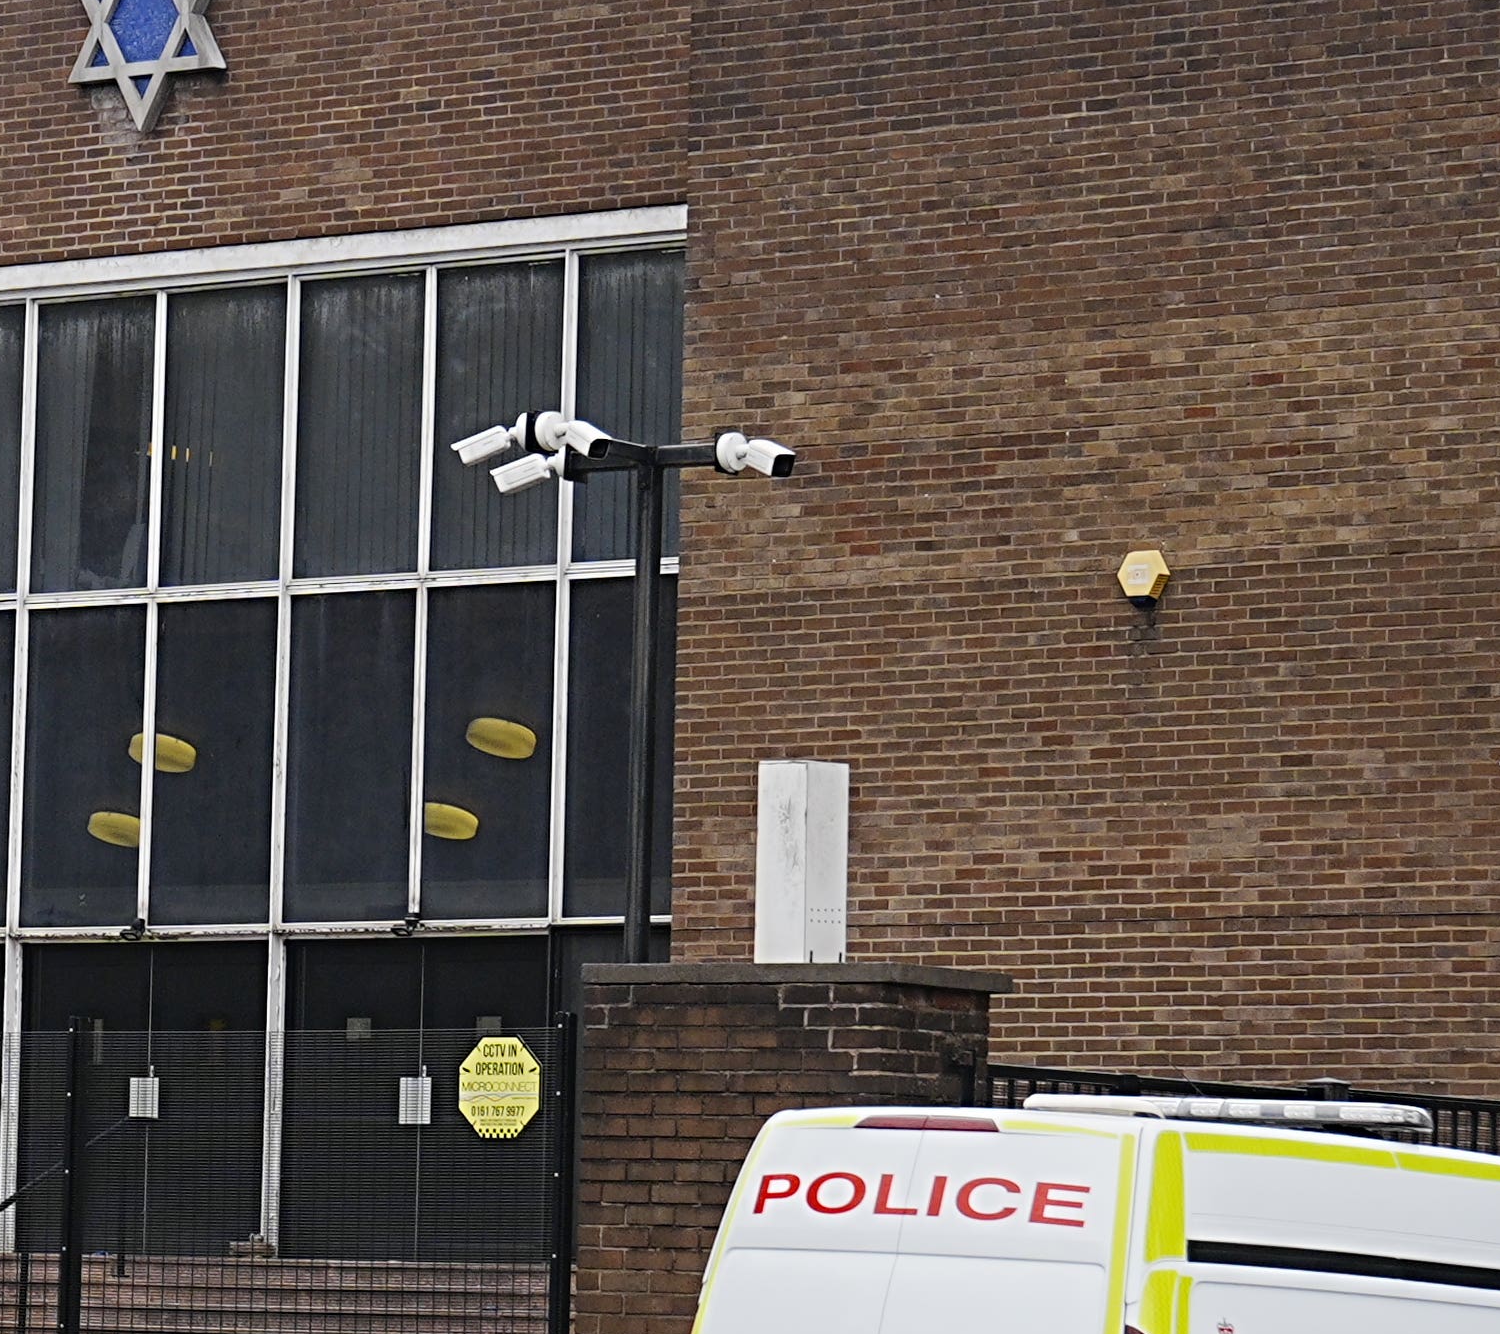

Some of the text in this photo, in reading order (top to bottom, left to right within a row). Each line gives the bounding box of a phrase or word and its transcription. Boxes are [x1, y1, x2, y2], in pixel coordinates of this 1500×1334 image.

[483, 1044, 518, 1058] CCTV IN
[475, 1062, 525, 1076] OPERATION
[462, 1081, 537, 1092] MICROCONNECT
[471, 1105, 489, 1117] 0161
[492, 1105, 505, 1117] 767
[752, 1171, 1091, 1228] POLICE
